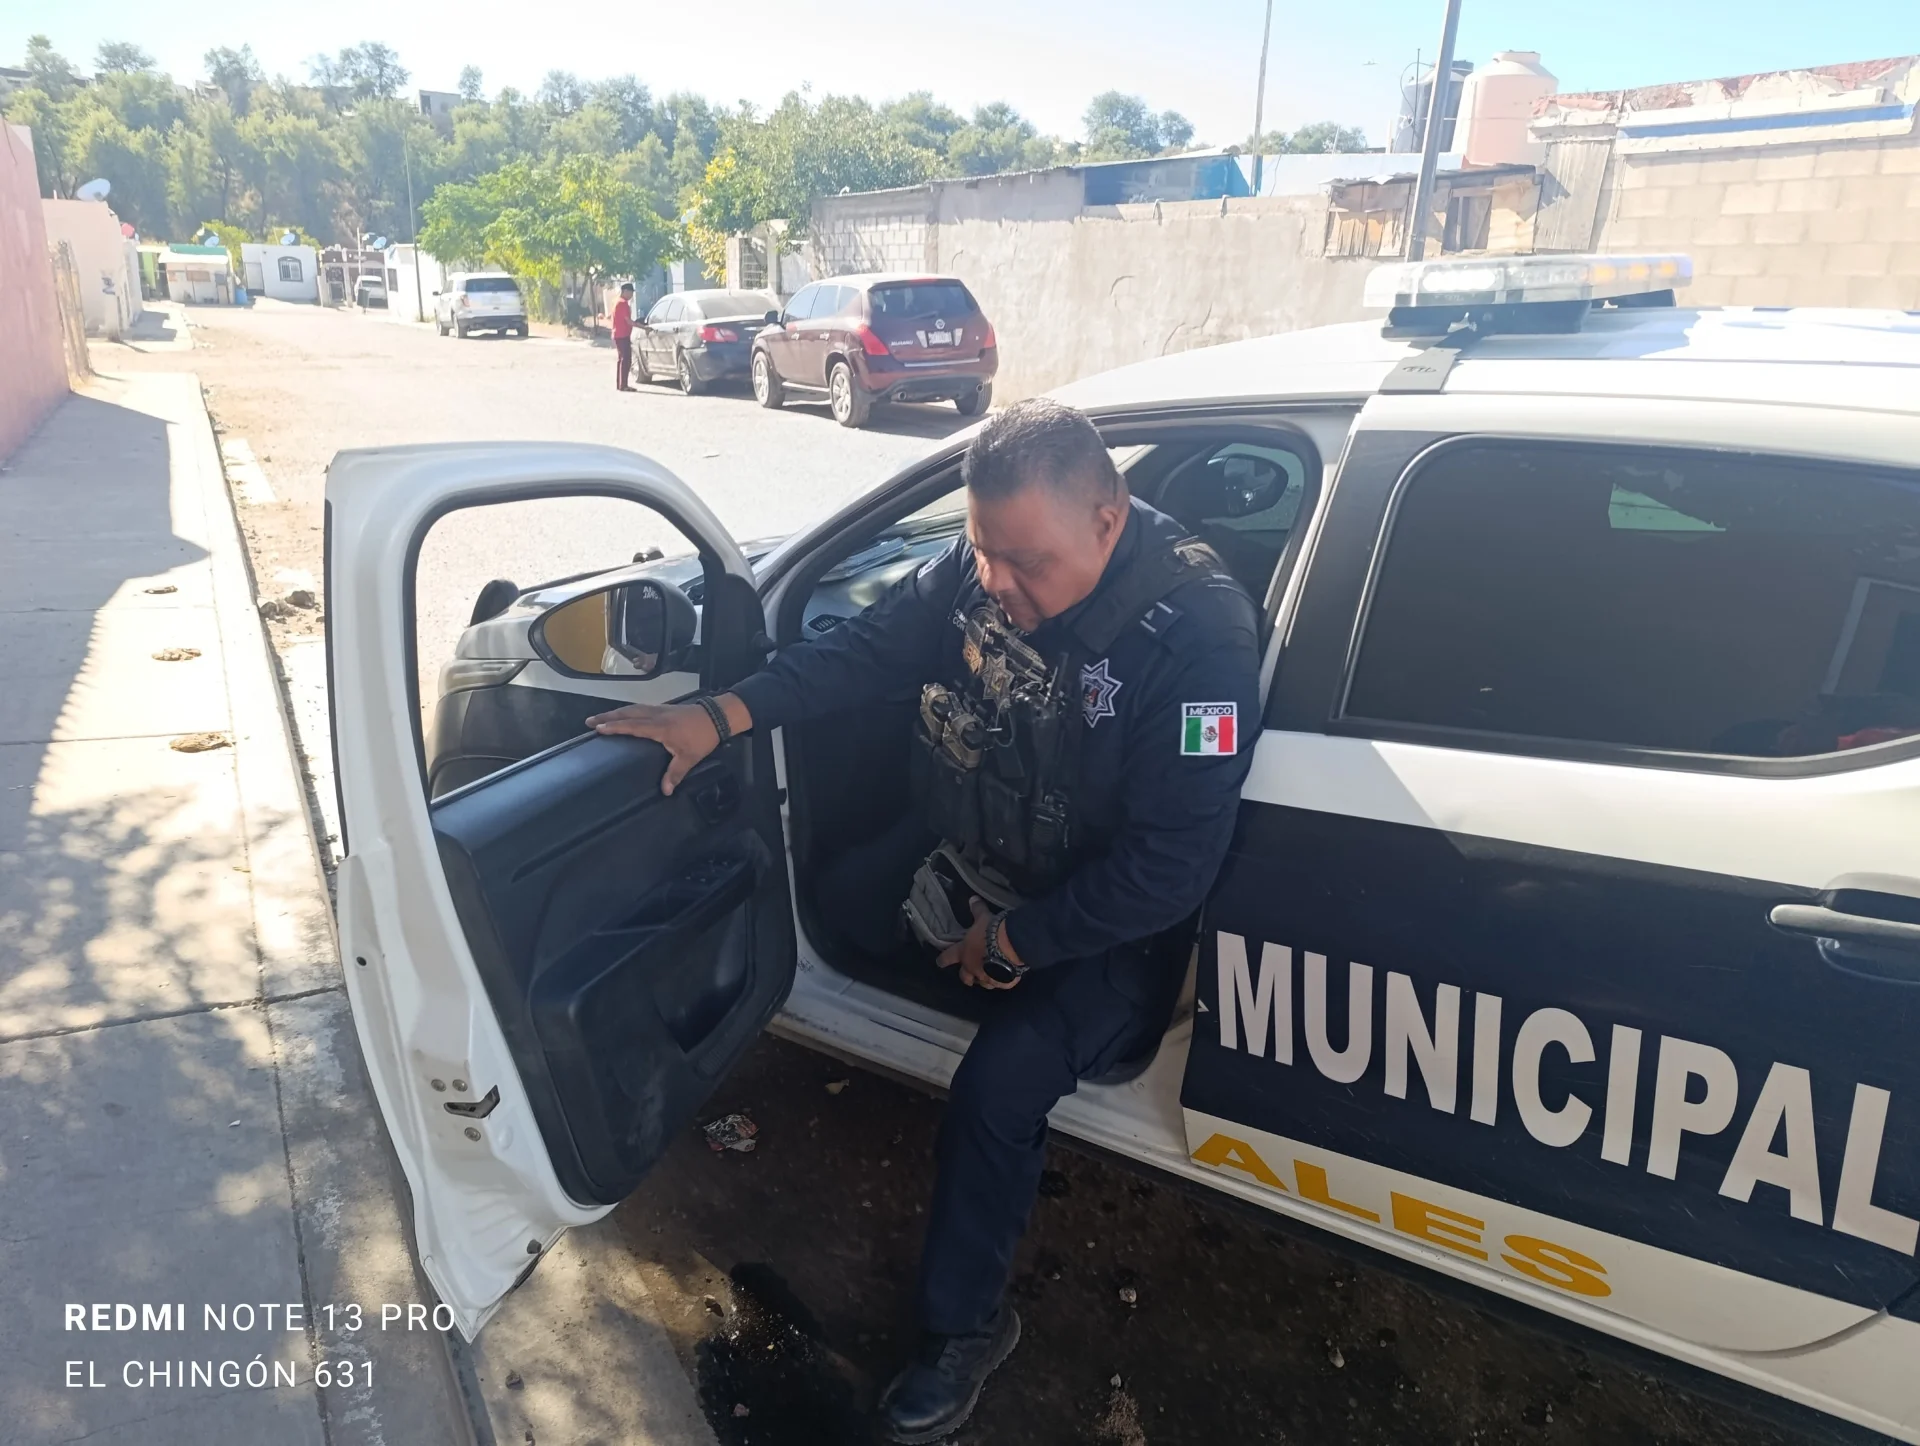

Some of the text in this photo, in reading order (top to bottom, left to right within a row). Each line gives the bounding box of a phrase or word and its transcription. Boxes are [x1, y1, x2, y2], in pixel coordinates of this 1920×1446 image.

[1190, 705, 1231, 715] MÉXICO
[1217, 930, 1920, 1257] MUNICIPAL
[1190, 1133, 1612, 1297] ALES
